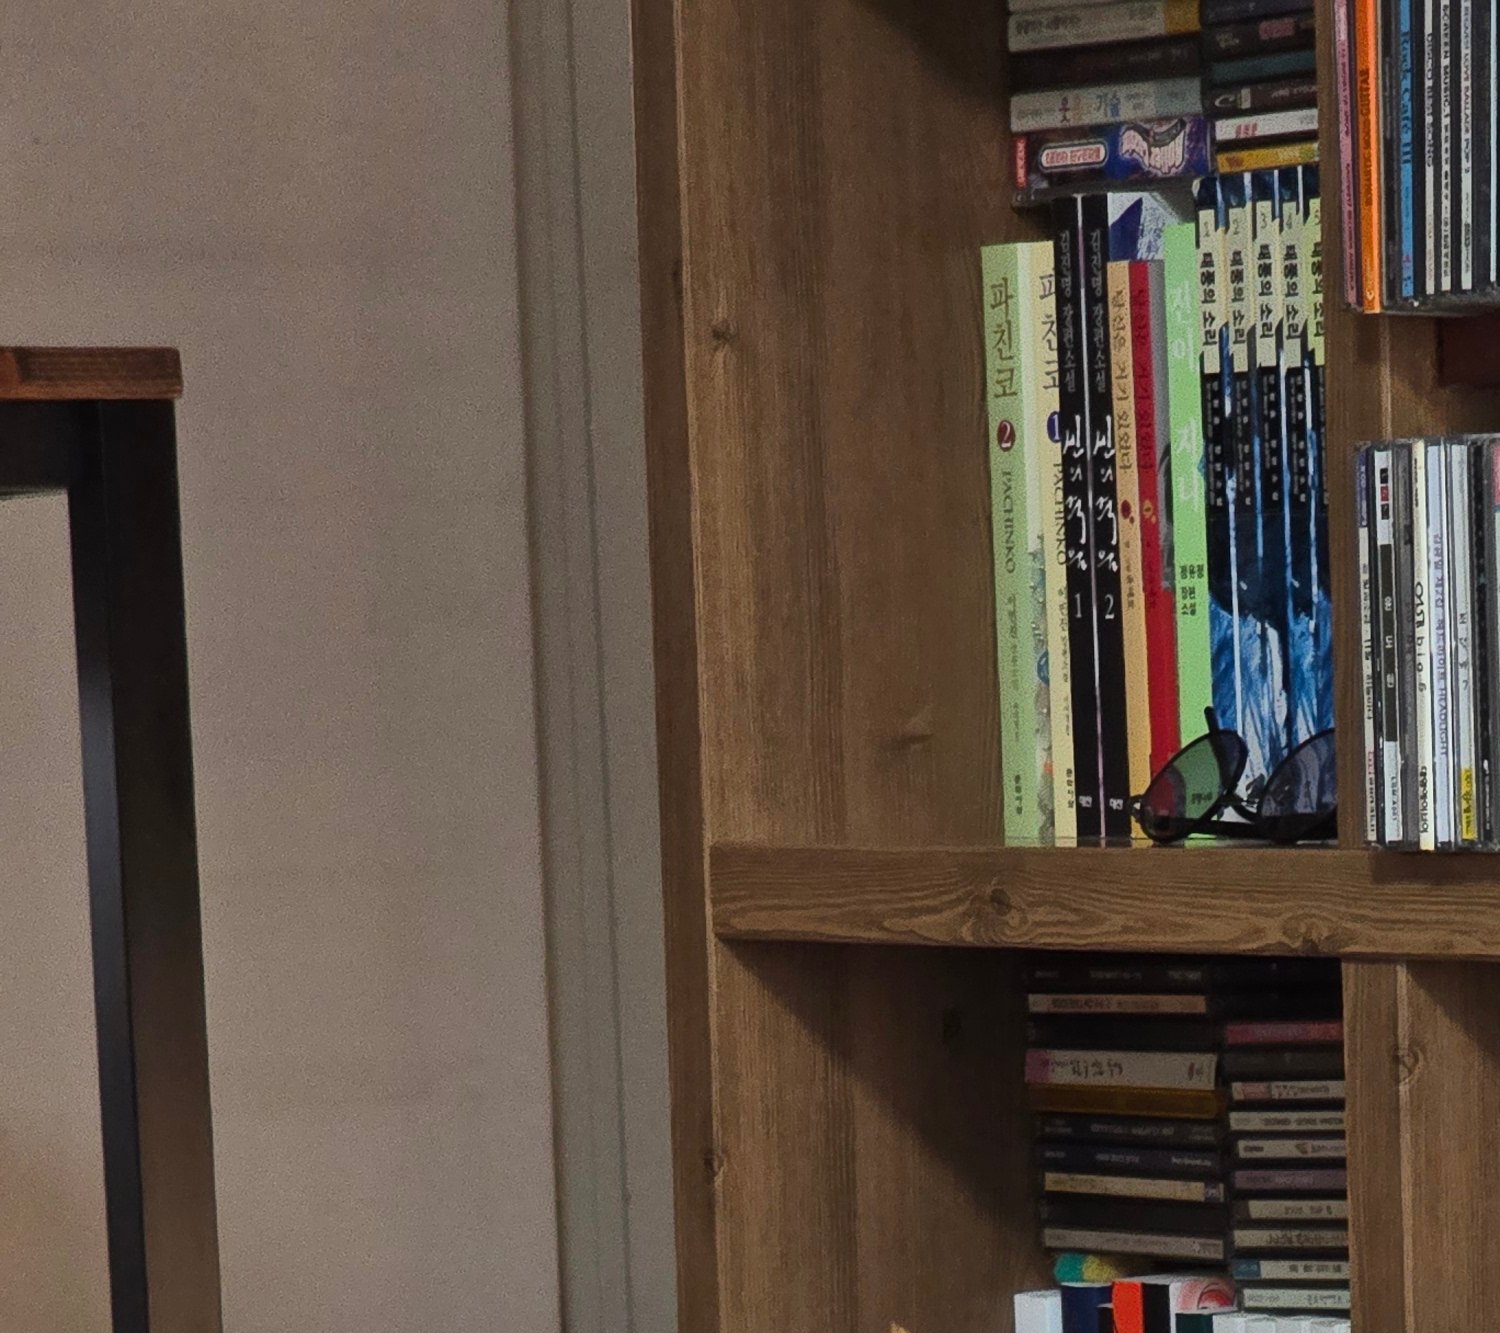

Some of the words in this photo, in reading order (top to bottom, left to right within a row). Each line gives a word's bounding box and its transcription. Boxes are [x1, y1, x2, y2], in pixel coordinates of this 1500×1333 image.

[1401, 32, 1411, 81] Rock
[988, 276, 1020, 400] 파친코
[1202, 311, 1218, 346] 소리
[1232, 309, 1246, 345] 소리
[1259, 302, 1274, 339] 소리
[1285, 304, 1301, 340] 소리
[1000, 423, 1013, 449] 2
[1052, 412, 1061, 442] 1
[1117, 411, 1132, 474] 있었다
[1062, 302, 1076, 392] 장편소설
[1074, 593, 1084, 618] 1
[1092, 302, 1106, 392] 장편소설
[1104, 594, 1115, 620] 2
[1001, 469, 1017, 574] PACHINKO
[1438, 687, 1448, 756] HEADLIGHT
